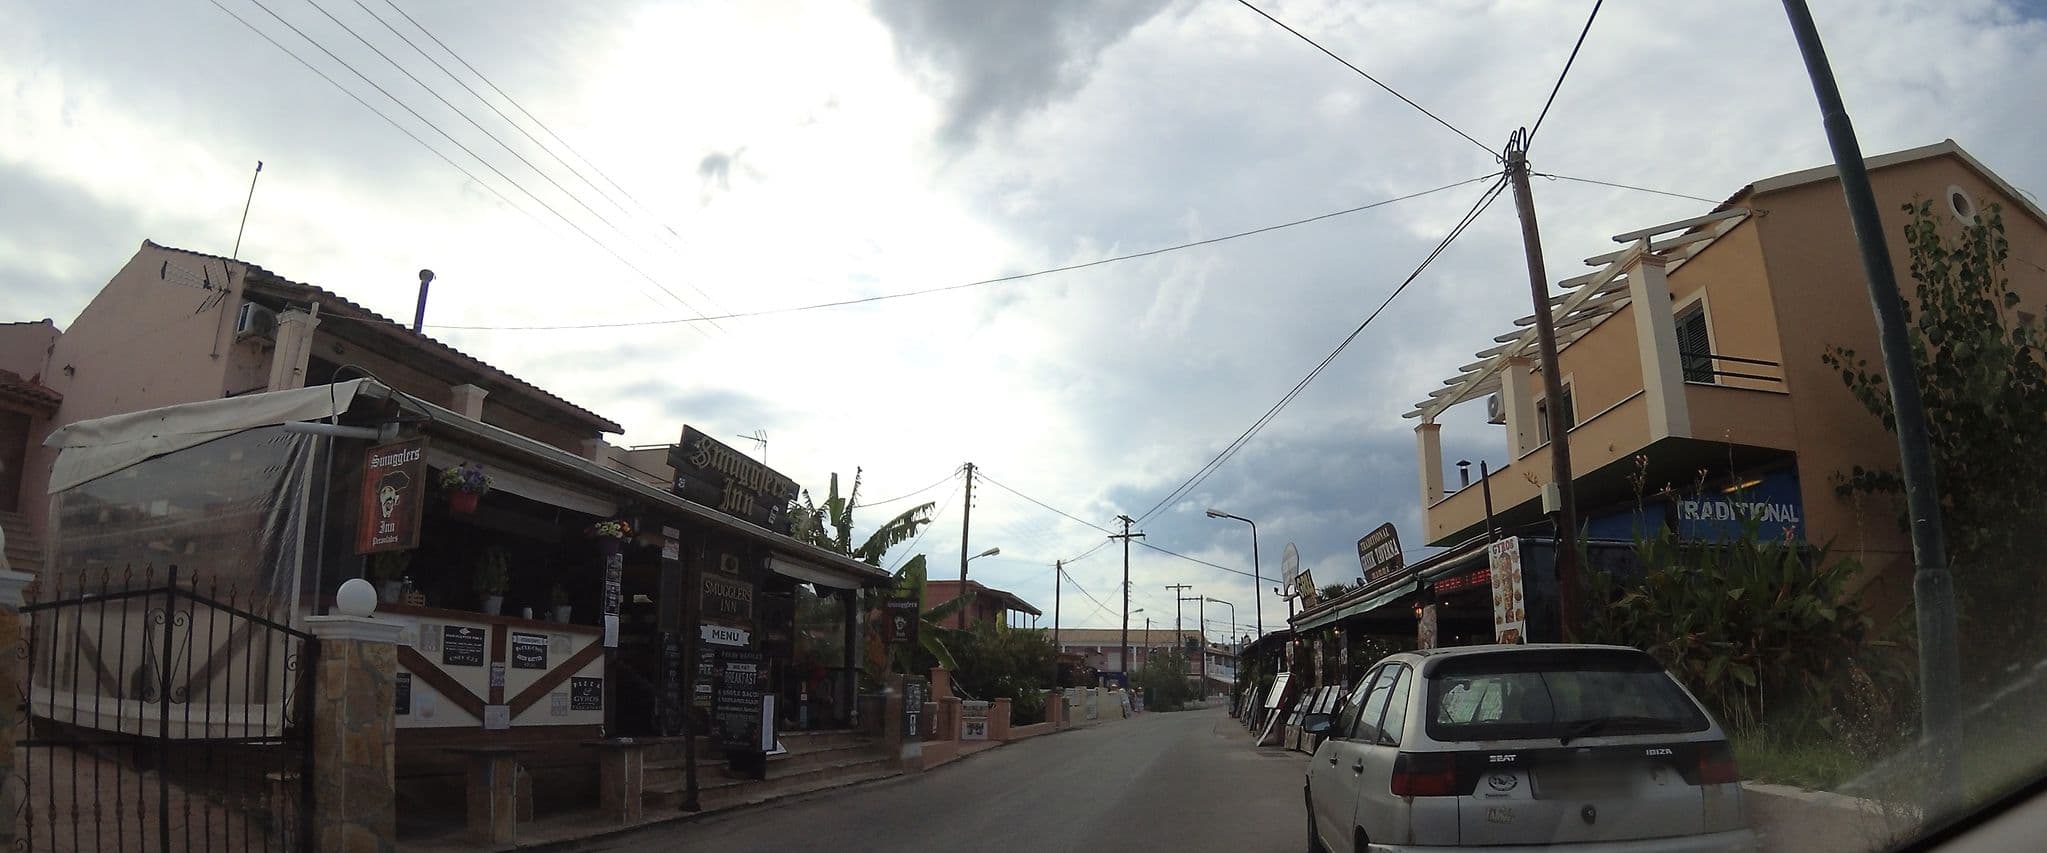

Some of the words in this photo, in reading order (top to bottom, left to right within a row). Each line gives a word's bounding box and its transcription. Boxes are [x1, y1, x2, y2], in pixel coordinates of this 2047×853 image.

[370, 447, 421, 469] Smugglers
[690, 437, 788, 498] Smugglers
[720, 476, 753, 516] Inn
[1677, 500, 1799, 522] TRADITIONAL
[378, 520, 396, 535] Inn
[1493, 539, 1514, 555] GYROS
[704, 580, 752, 601] SMUGGLERS
[720, 597, 737, 613] INN
[712, 629, 740, 642] MENU
[1489, 754, 1517, 763] SEAT
[1646, 748, 1673, 756] IBIZA
